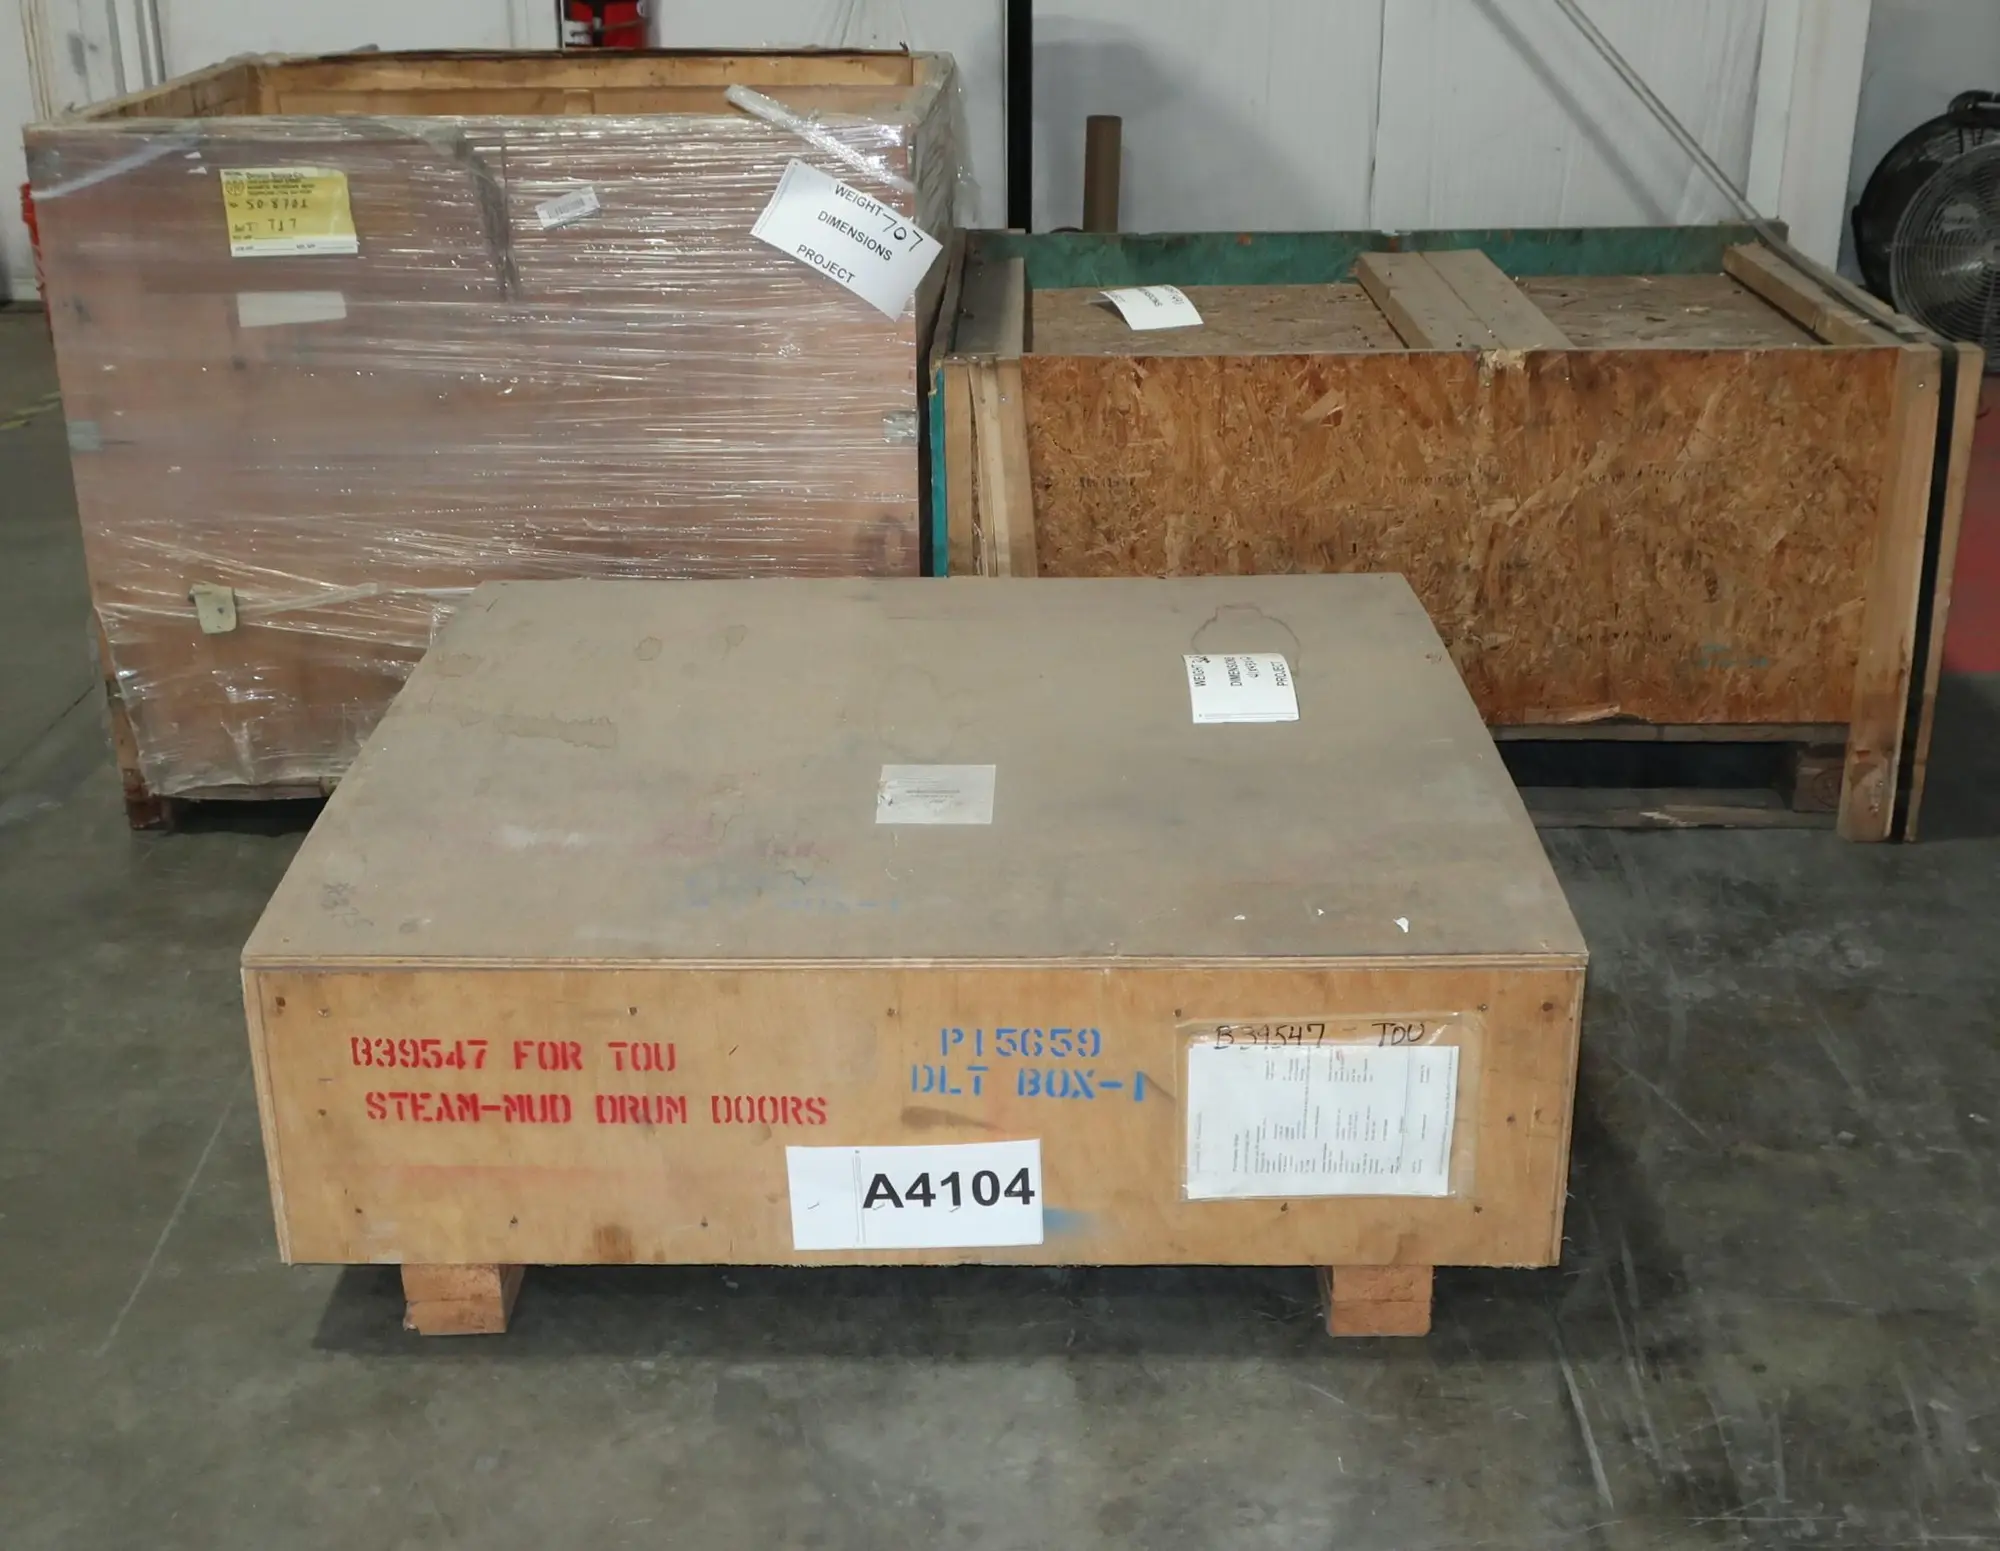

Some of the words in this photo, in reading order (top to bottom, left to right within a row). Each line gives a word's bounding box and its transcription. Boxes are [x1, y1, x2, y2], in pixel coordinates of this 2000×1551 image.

[817, 210, 893, 261] DIMENSIONS
[835, 184, 883, 216] WEIGHT
[882, 213, 924, 252] 707
[796, 244, 855, 283] PROJECT
[351, 1037, 488, 1069] B39547
[513, 1040, 584, 1071] FOR
[607, 1041, 677, 1072] TOU
[911, 1064, 988, 1096] DLT
[1017, 1068, 1145, 1102] BOX-1
[365, 1091, 573, 1124] STEAM-MUD
[595, 1094, 688, 1125] DRUM
[711, 1095, 828, 1126] DOORS
[862, 1167, 1035, 1209] A4104
